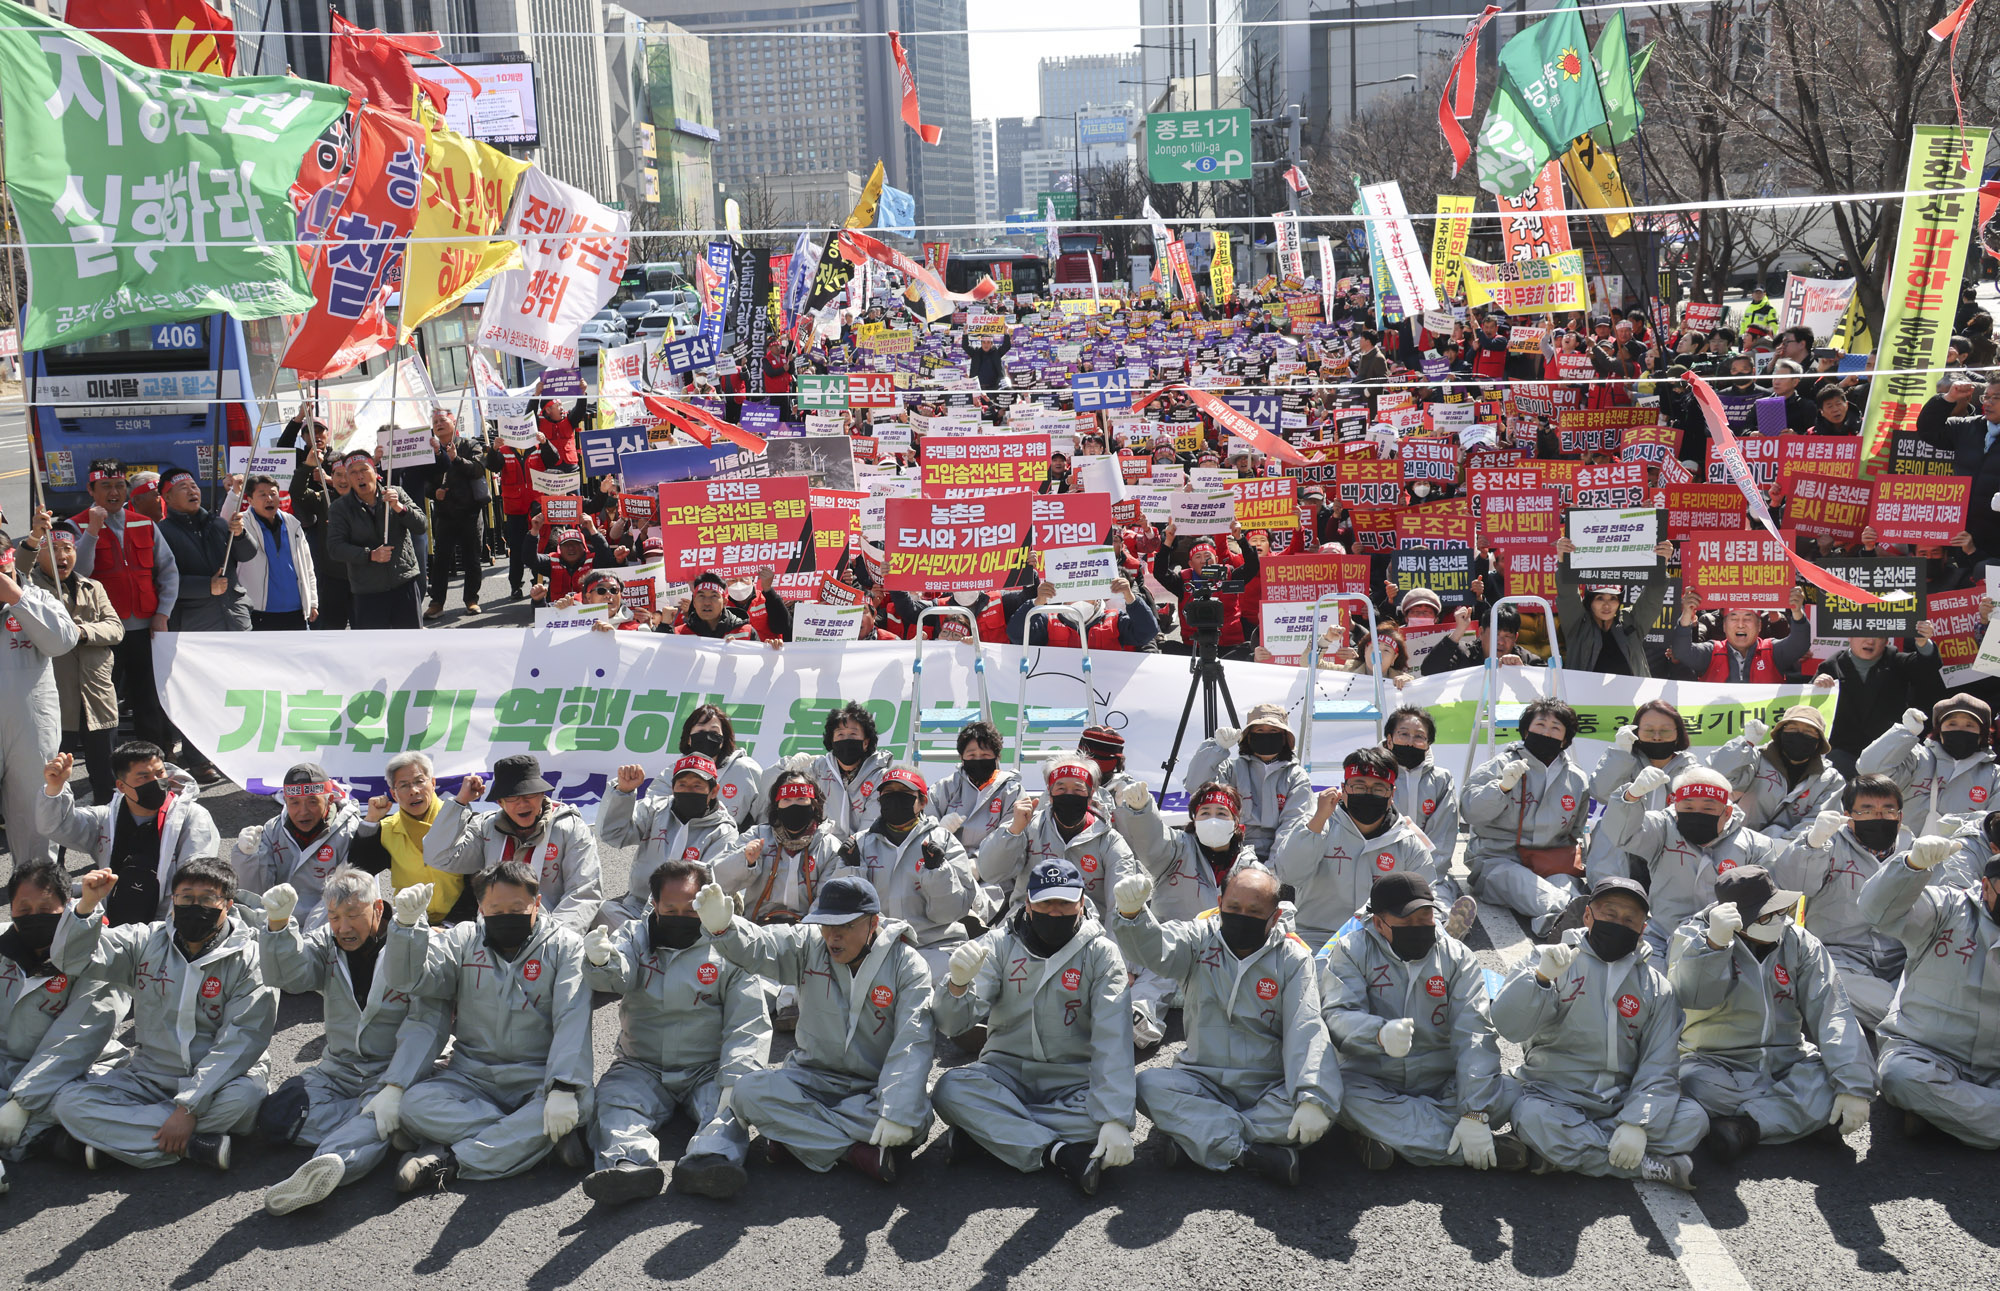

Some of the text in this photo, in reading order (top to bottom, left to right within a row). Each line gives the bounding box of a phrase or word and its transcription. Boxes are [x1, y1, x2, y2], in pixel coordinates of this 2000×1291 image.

[1155, 116, 1239, 140] 종로1가
[1155, 142, 1220, 155] Jongno 1(il)-ga
[1202, 159, 1210, 171] 6
[1914, 137, 1973, 222] 문화유산
[52, 161, 265, 278] 실행하라
[1446, 260, 1460, 278] 맛
[1906, 227, 1959, 311] 파괴하는
[520, 269, 570, 324] 쟁취
[1514, 285, 1546, 307] 무효화
[1547, 282, 1575, 304] 하라!
[157, 325, 197, 348] 406
[670, 339, 711, 370] 금산
[1888, 317, 1938, 397] 송전탑은
[50, 385, 70, 397] 웰스
[87, 375, 217, 399] 미네랄 교원 웰스
[803, 379, 846, 405] 금산
[849, 376, 892, 403] 금산
[1077, 374, 1125, 405] 금산
[1560, 413, 1585, 427] 송전선로
[1605, 408, 1629, 424] 송전선로
[1156, 423, 1197, 437] 주민없는
[1623, 429, 1676, 446] 무조건
[926, 442, 1047, 460] 주민들의 안전과 건강 위협
[1401, 444, 1454, 461] 송전탑이
[1786, 441, 1858, 460] 지역 생존권 위협!
[1897, 439, 1915, 457] 안전
[250, 464, 277, 473] 분산하고
[261, 457, 287, 466] 전력수요
[1121, 459, 1147, 468] 송전철탑
[1895, 459, 1925, 475] 주민이
[924, 460, 1048, 485] 고압송전선로 건설
[1121, 467, 1147, 476] 건설반대
[1285, 464, 1337, 485] 백지화
[1340, 462, 1399, 481] 무조건
[1576, 464, 1643, 488] 송전선로
[1230, 480, 1292, 500] 송전선로
[1472, 472, 1537, 491] 송전선로
[706, 482, 761, 502] 한전은
[1340, 483, 1401, 506] 백지화
[1669, 492, 1743, 510] 왜 우리지역인가?
[1793, 479, 1871, 505] 세종시 송전선로
[1878, 482, 1966, 502] 왜 우리지역인가?
[548, 499, 577, 509] 송전철탑
[624, 497, 651, 508] 송전철탑
[625, 506, 652, 516] 건설반대
[1180, 502, 1226, 511] 수도권 전력수요
[1233, 498, 1294, 520] 결사반대!
[1486, 495, 1554, 513] 세종시 송전선로
[547, 509, 577, 518] 건설반대
[667, 499, 807, 526] 고압송전선로·철탑
[930, 504, 986, 526] 농촌은
[1669, 512, 1742, 529] 정당한 절차부터 지켜라
[1789, 499, 1865, 527] 결사 반대!!
[1876, 503, 1962, 524] 정당한 절차부터 지켜라
[1401, 515, 1467, 538] 무조건
[1485, 512, 1554, 534] 결사 반대!!
[1582, 523, 1645, 535] 수도권 전력수요
[697, 522, 779, 545] 건설계획을
[897, 522, 1017, 549] 도시와 기업의
[1042, 522, 1097, 546] 기업의
[1493, 536, 1510, 544] 세종시
[1596, 534, 1631, 544] 분산하고
[1882, 529, 1949, 540] 세종시 장군면 주민일동
[679, 541, 803, 568] 전면 철회하라!
[1698, 540, 1720, 562] 지역
[1725, 540, 1758, 562] 생존권
[888, 546, 1029, 577] 전기식민지가 아니다!
[1054, 557, 1110, 571] 수도권 전력수요
[1397, 554, 1469, 572] 세종시 송전선로
[1068, 568, 1100, 580] 분산하고
[1265, 562, 1339, 583] 왜 우리지역인가?
[1430, 571, 1470, 591] 반대!!
[1578, 570, 1649, 580] 세종시 장군면 주민일동
[1697, 564, 1790, 587] 송전선로 반대한다!
[1873, 566, 1917, 588] 송전선로
[924, 578, 994, 591] 영암군 대책위원회
[1707, 592, 1780, 602] 세종시 장군면 주민일동
[1274, 615, 1297, 625] 수도권
[1832, 618, 1907, 631] 세종시 주민일동
[216, 686, 765, 758] 기후위기 역행하는
[1051, 766, 1089, 779] 결사반대
[779, 786, 815, 797] 결사반대
[1681, 786, 1726, 800] 결사반대
[1430, 1003, 1446, 1027] 6
